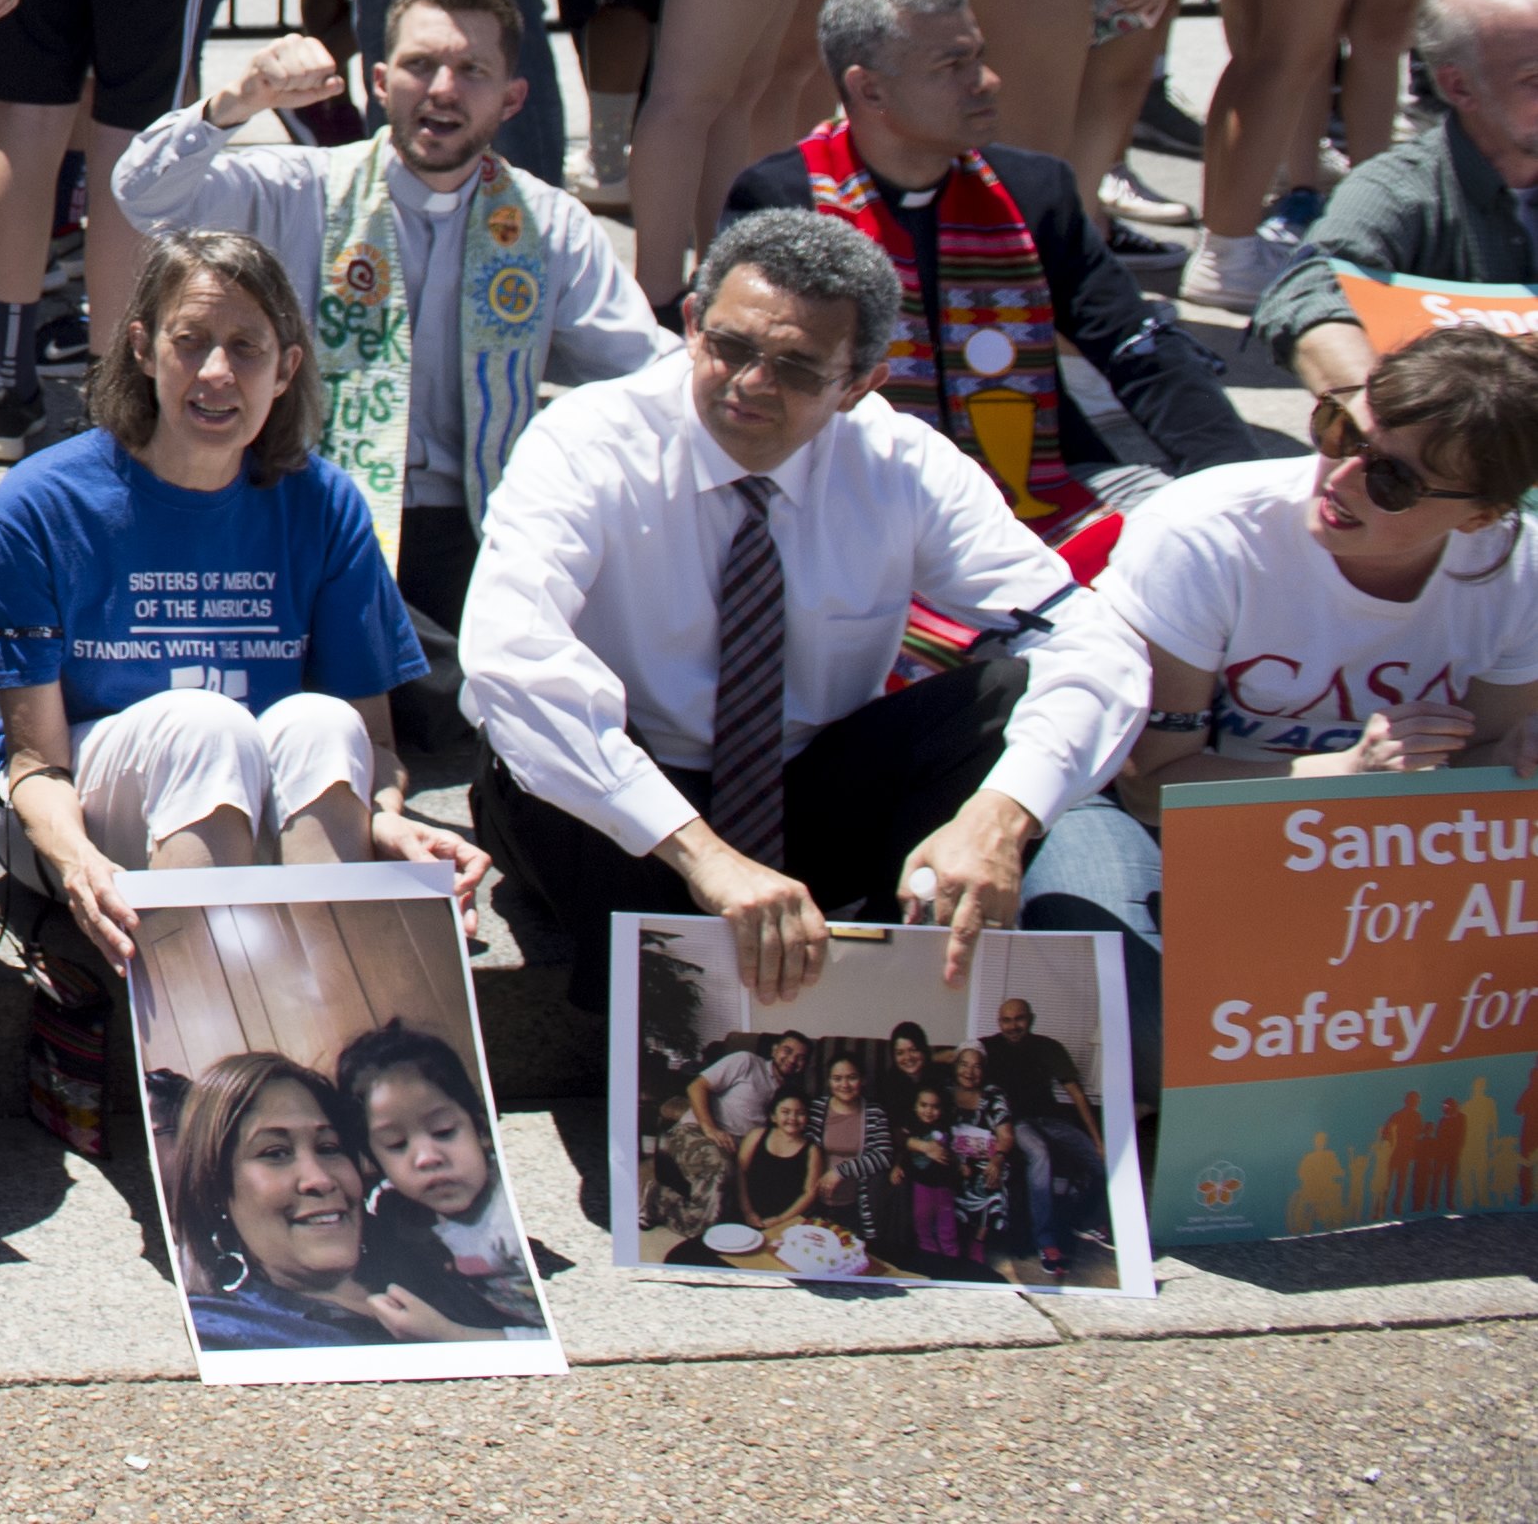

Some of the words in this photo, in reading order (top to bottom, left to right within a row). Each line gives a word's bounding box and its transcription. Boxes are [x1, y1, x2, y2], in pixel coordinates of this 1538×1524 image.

[129, 573, 198, 592] SISTERS
[202, 573, 218, 591] OF
[223, 572, 276, 590] MERCY
[134, 599, 159, 618] OF
[163, 599, 197, 618] THE
[201, 598, 272, 618] AMERICAS
[73, 639, 161, 660] STANDING
[165, 639, 215, 658] WITH
[219, 640, 239, 658] THE
[1328, 881, 1434, 966] for
[1211, 991, 1437, 1062] Safety
[1440, 972, 1538, 1053] for
